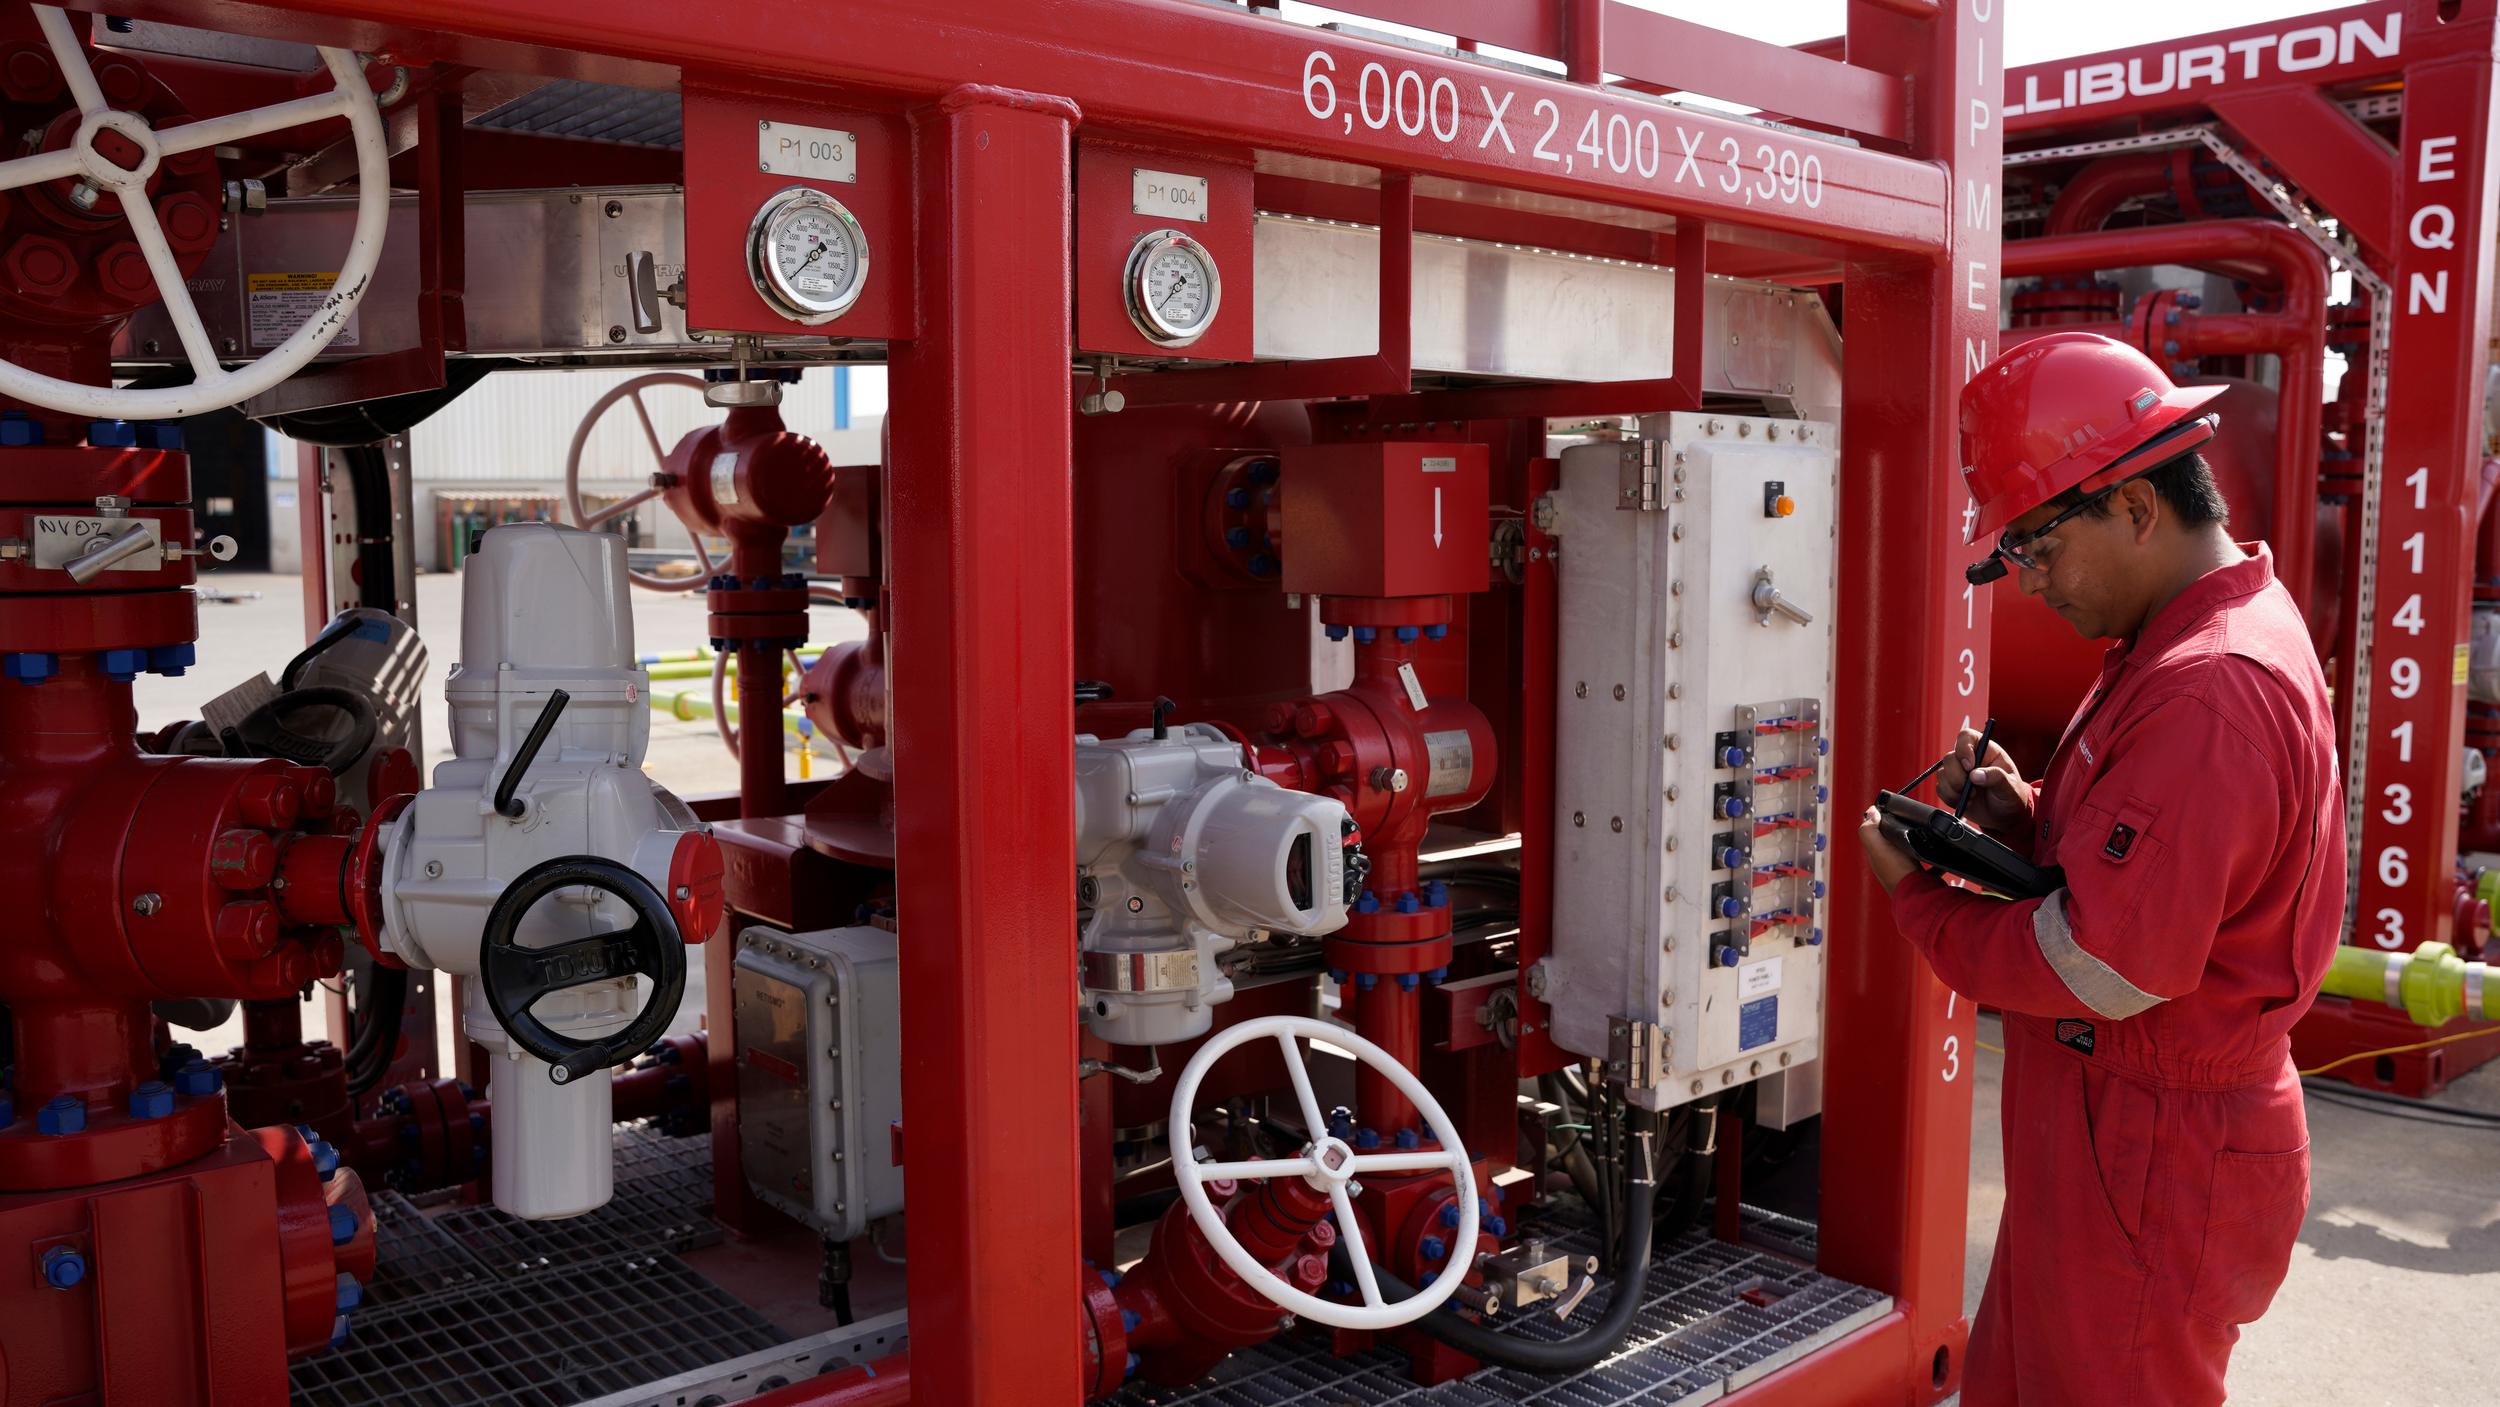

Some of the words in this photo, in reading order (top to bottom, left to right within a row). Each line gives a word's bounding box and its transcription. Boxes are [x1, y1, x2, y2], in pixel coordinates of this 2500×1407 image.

[1303, 50, 1459, 143] 6,000
[1478, 85, 1516, 154] X
[1533, 98, 1660, 178] 2,400
[1674, 126, 1706, 188] X
[1719, 136, 1823, 208] 3,390
[809, 141, 843, 162] 003
[1170, 187, 1196, 205] 004
[2409, 135, 2457, 315] EQN
[535, 940, 638, 987] rotork
[2080, 1035, 2093, 1043] RED
